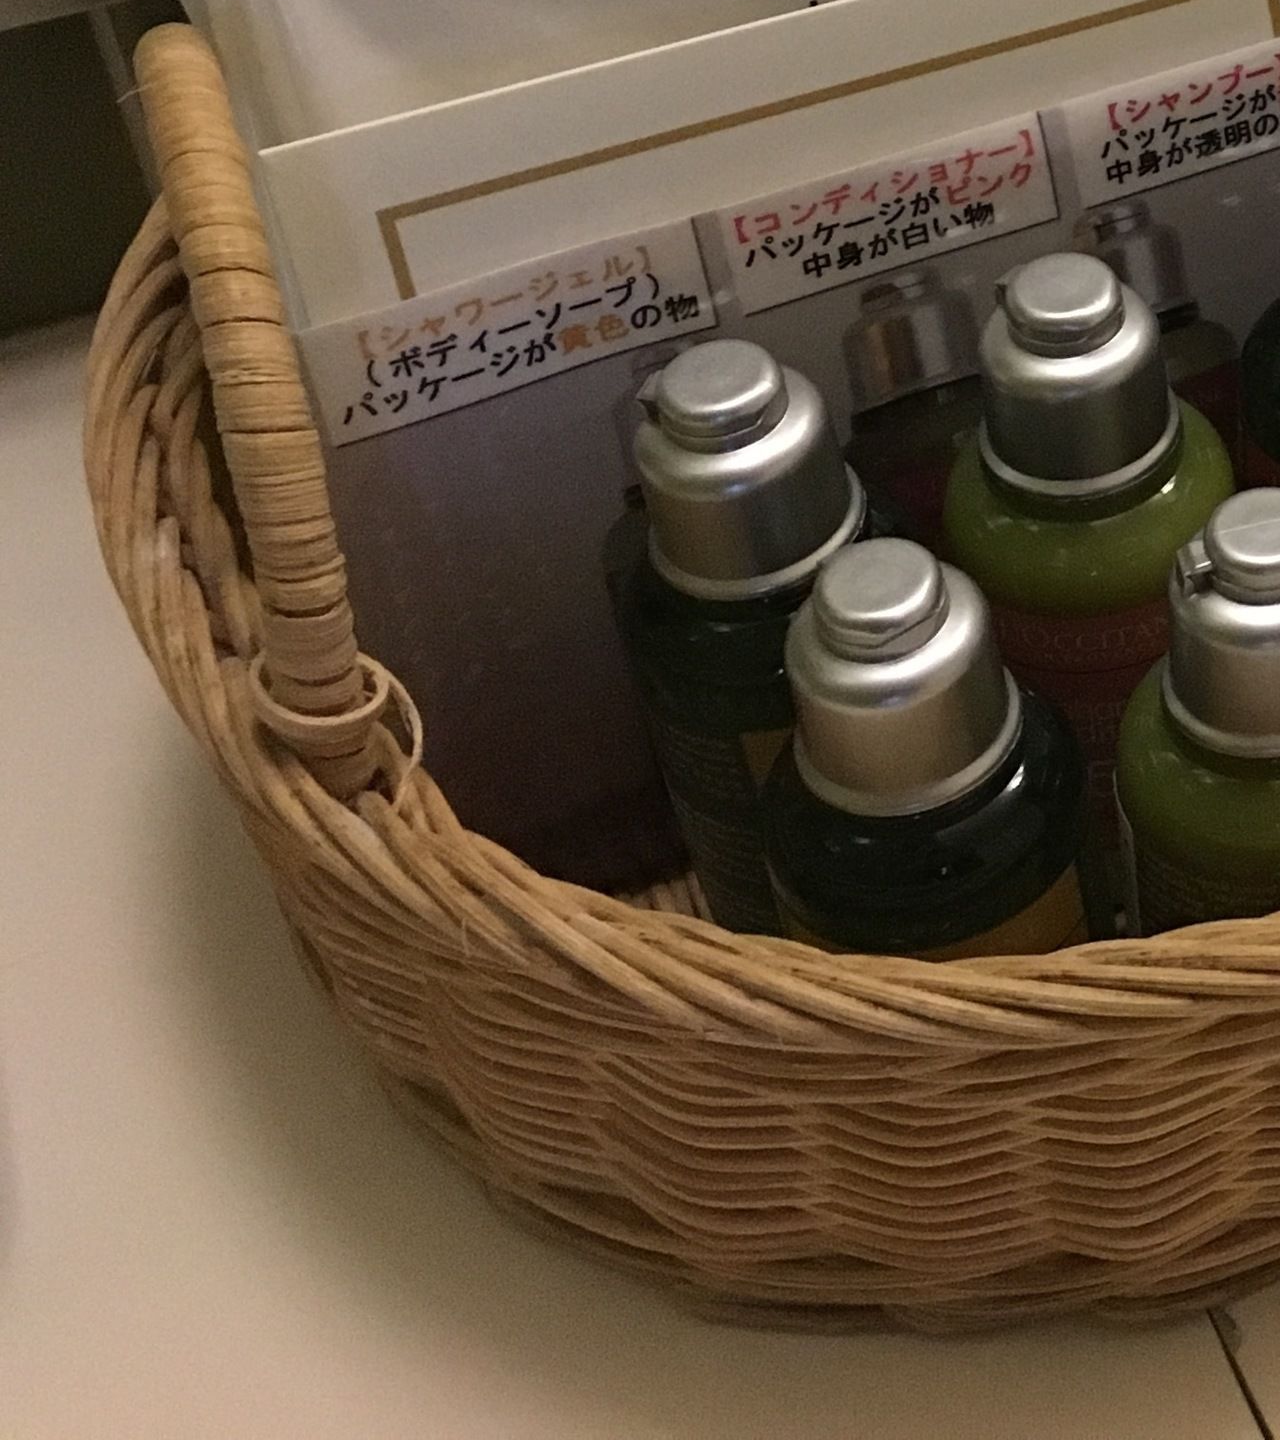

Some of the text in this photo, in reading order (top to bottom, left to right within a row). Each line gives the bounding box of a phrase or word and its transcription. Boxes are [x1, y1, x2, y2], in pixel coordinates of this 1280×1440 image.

[745, 162, 1032, 268] パッケージがピンク
[803, 201, 996, 278] 中身が白い物
[343, 294, 700, 425] パッケージが黄色の物
